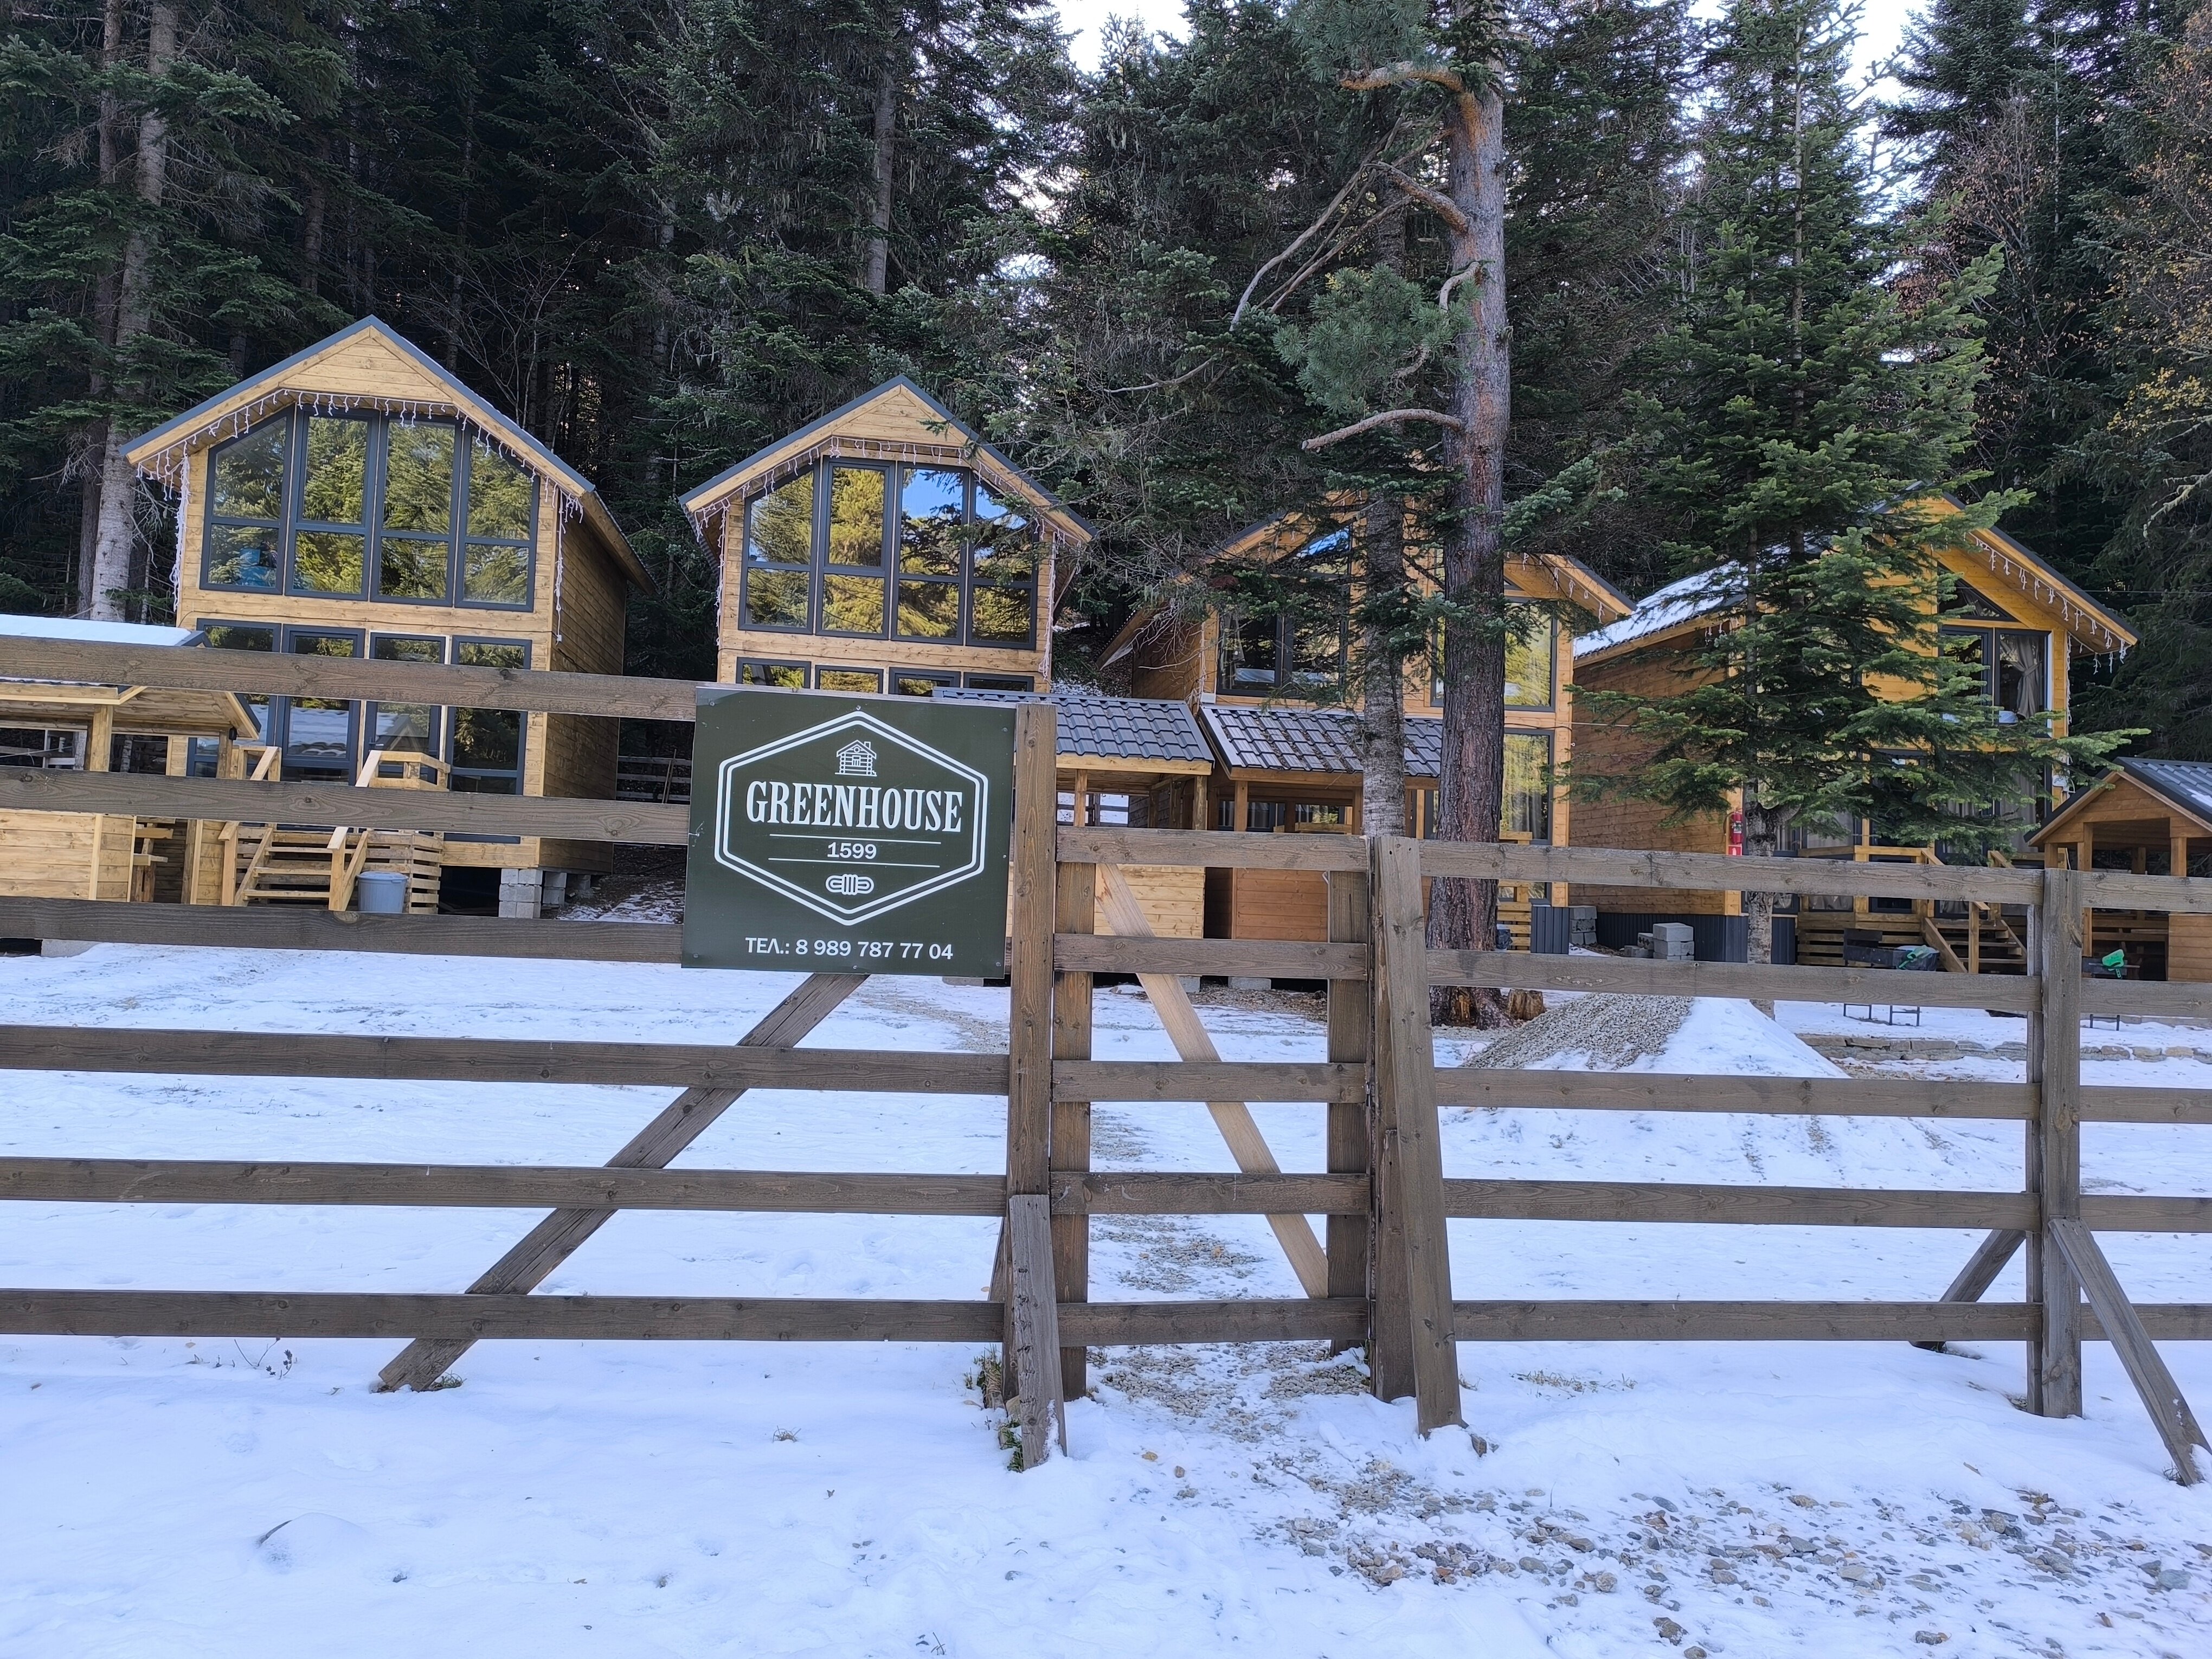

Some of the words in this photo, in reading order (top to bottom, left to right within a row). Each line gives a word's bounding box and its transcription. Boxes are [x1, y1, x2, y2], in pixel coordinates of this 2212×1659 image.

[746, 780, 963, 833] GREENHOUSE
[827, 841, 877, 859] 1599
[745, 937, 790, 955] ТЕЛ.:
[795, 939, 808, 955] 8
[814, 940, 851, 956] 989
[857, 941, 894, 958] 787
[900, 942, 923, 959] 77
[929, 943, 954, 960] 04
